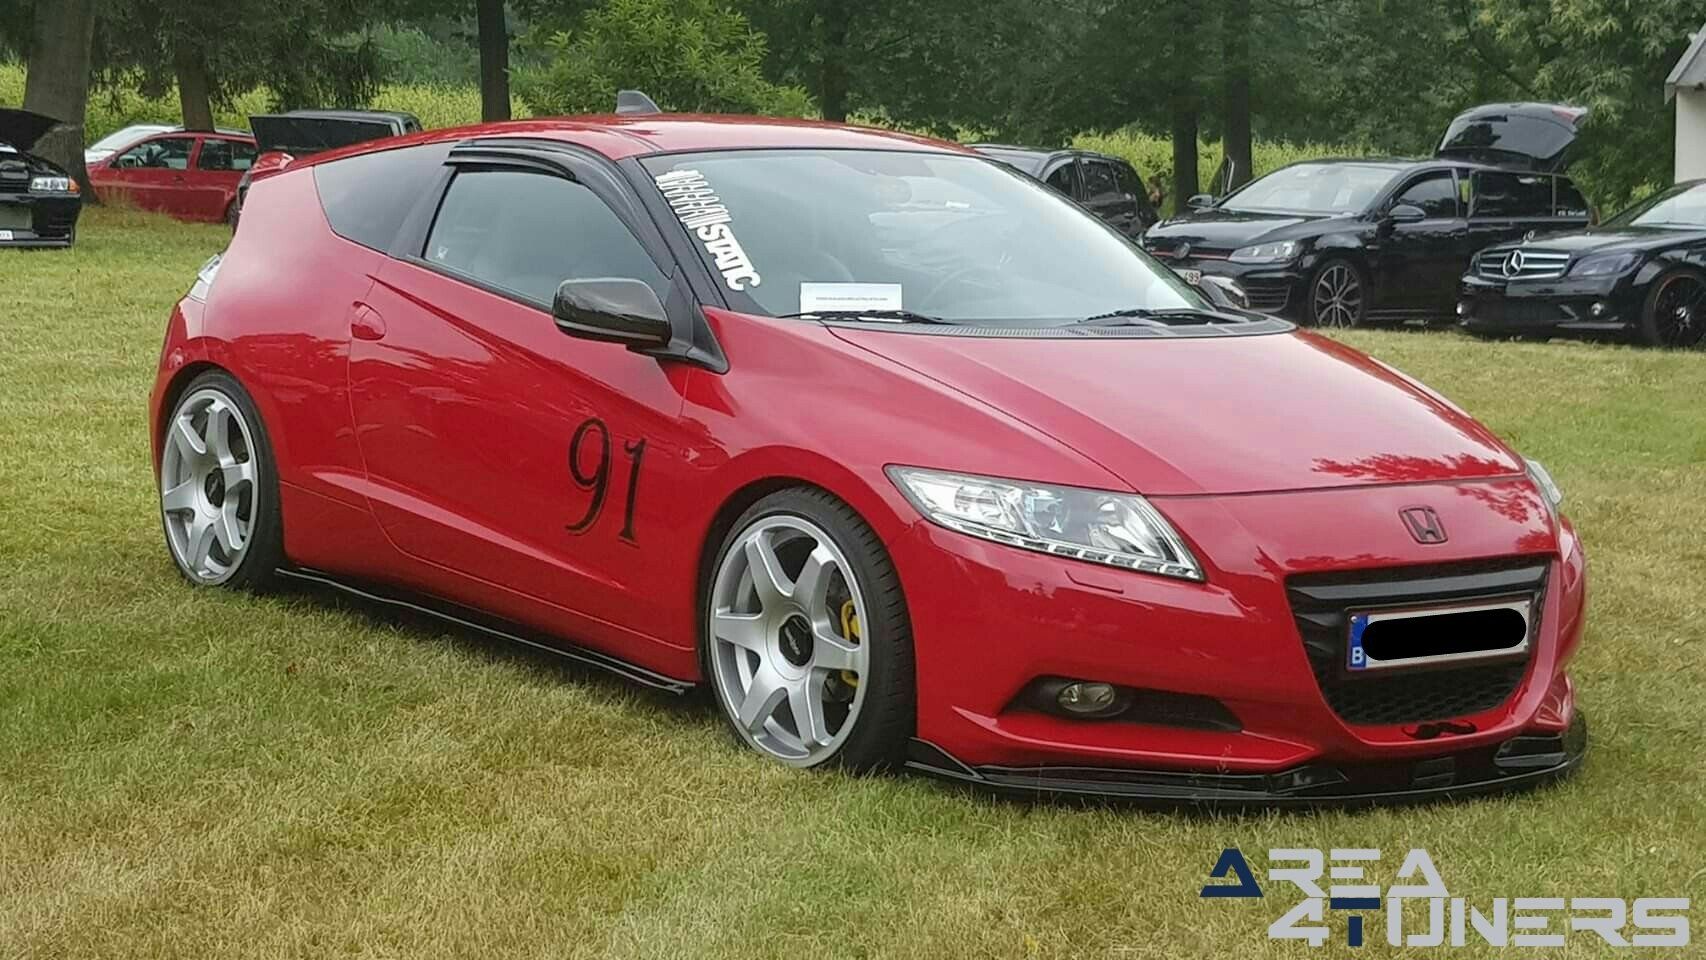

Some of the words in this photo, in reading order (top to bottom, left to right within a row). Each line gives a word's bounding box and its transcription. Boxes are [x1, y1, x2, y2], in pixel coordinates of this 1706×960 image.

[697, 223, 761, 291] STATIC
[565, 417, 647, 547] 91
[1352, 646, 1364, 664] B
